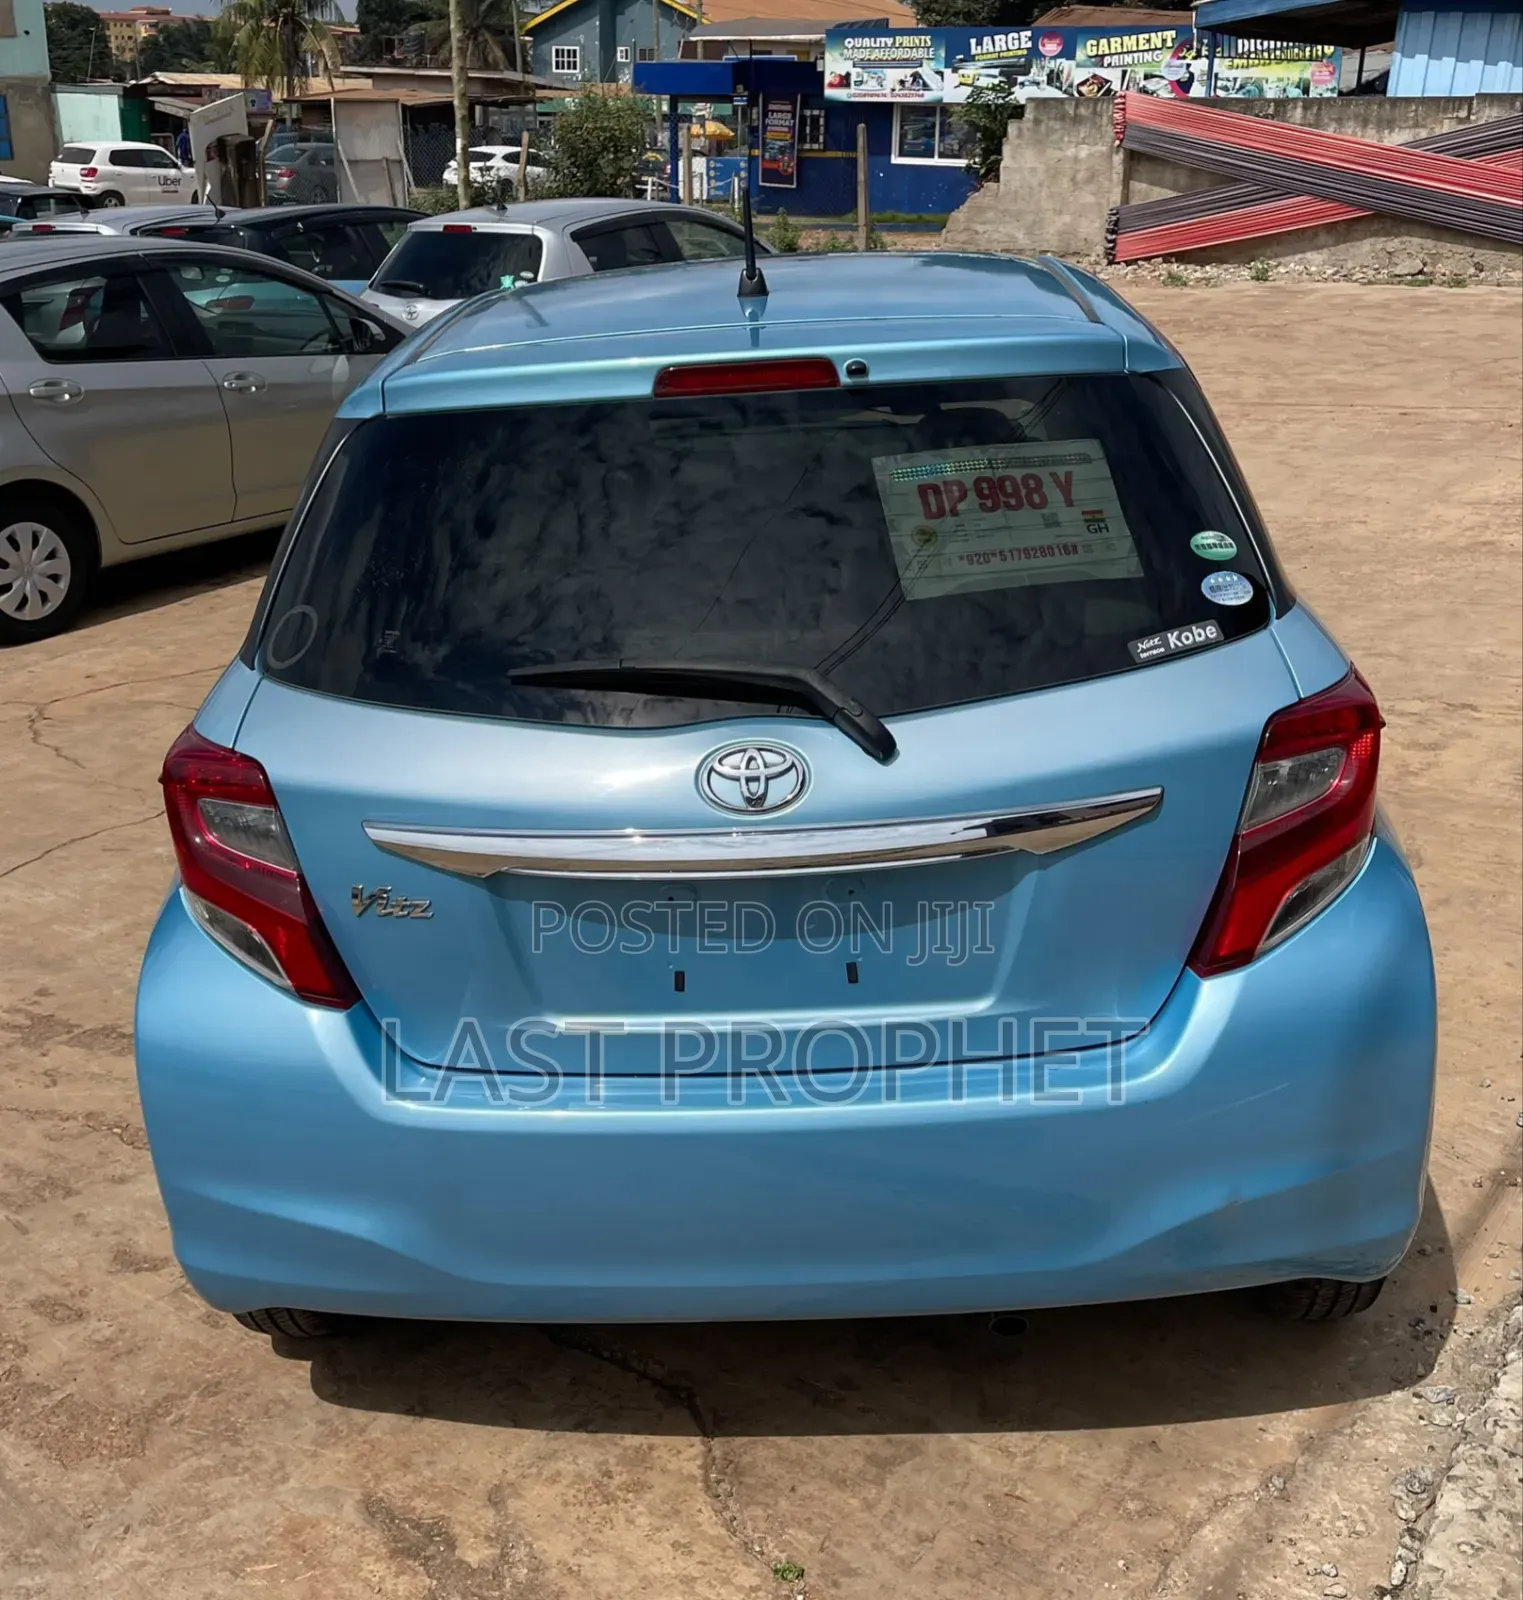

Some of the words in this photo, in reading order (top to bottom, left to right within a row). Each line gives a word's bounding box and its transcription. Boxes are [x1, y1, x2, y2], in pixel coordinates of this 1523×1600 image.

[844, 37, 893, 48] QUALITY
[895, 35, 931, 47] PRINTS
[970, 30, 1032, 55] LARGE
[1086, 30, 1176, 56] GARMENT
[843, 48, 870, 60] MADE
[873, 47, 935, 59] AFFORDABLE
[158, 175, 182, 186] Uber
[917, 479, 968, 519] DP
[973, 473, 1048, 513] 998
[1049, 471, 1074, 507] Y
[1086, 522, 1110, 534] GH
[1167, 625, 1217, 649] Kobe
[1140, 647, 1165, 658] terrace
[352, 884, 434, 919] Vitz
